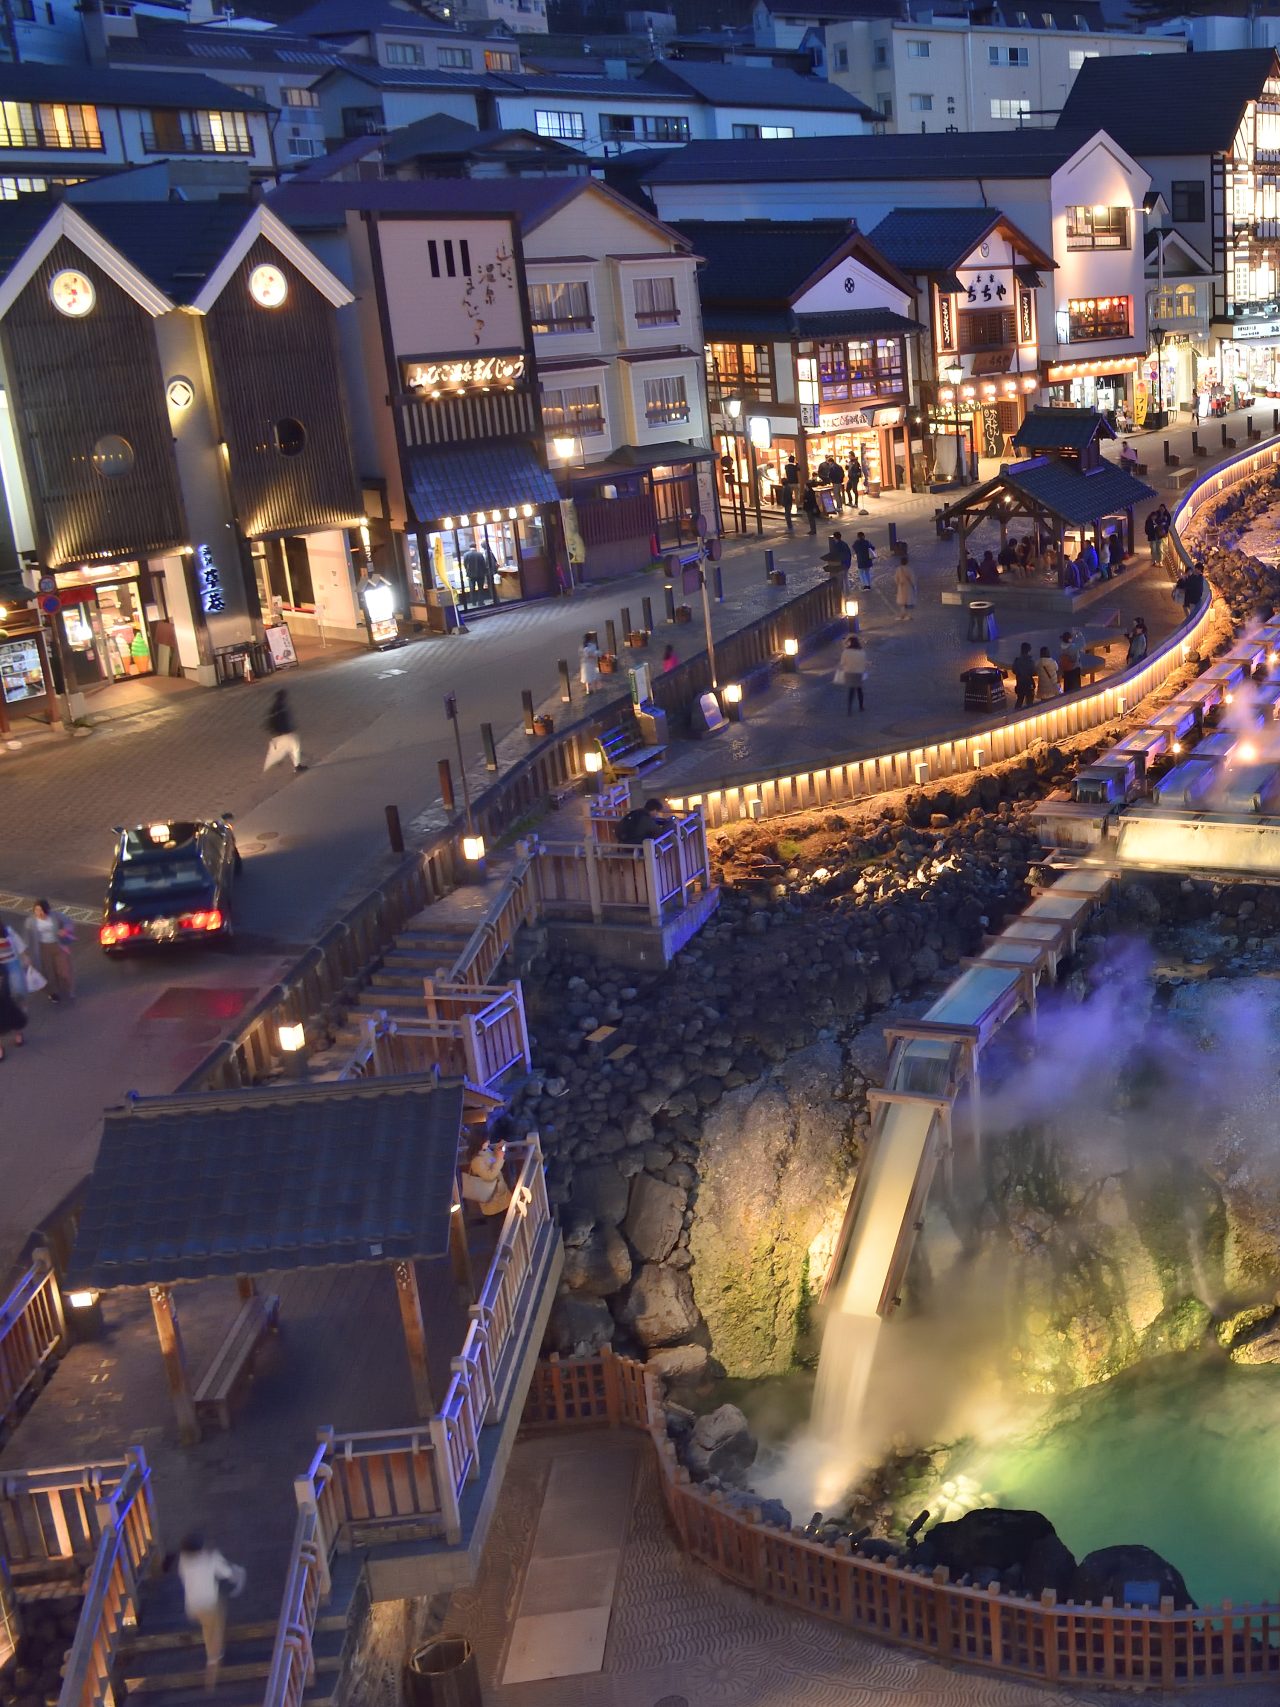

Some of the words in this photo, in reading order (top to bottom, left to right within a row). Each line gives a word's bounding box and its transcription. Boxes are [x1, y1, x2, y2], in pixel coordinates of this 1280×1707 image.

[967, 284, 1007, 303] ちちや
[409, 355, 525, 388] 山びこ温泉まんじゅう
